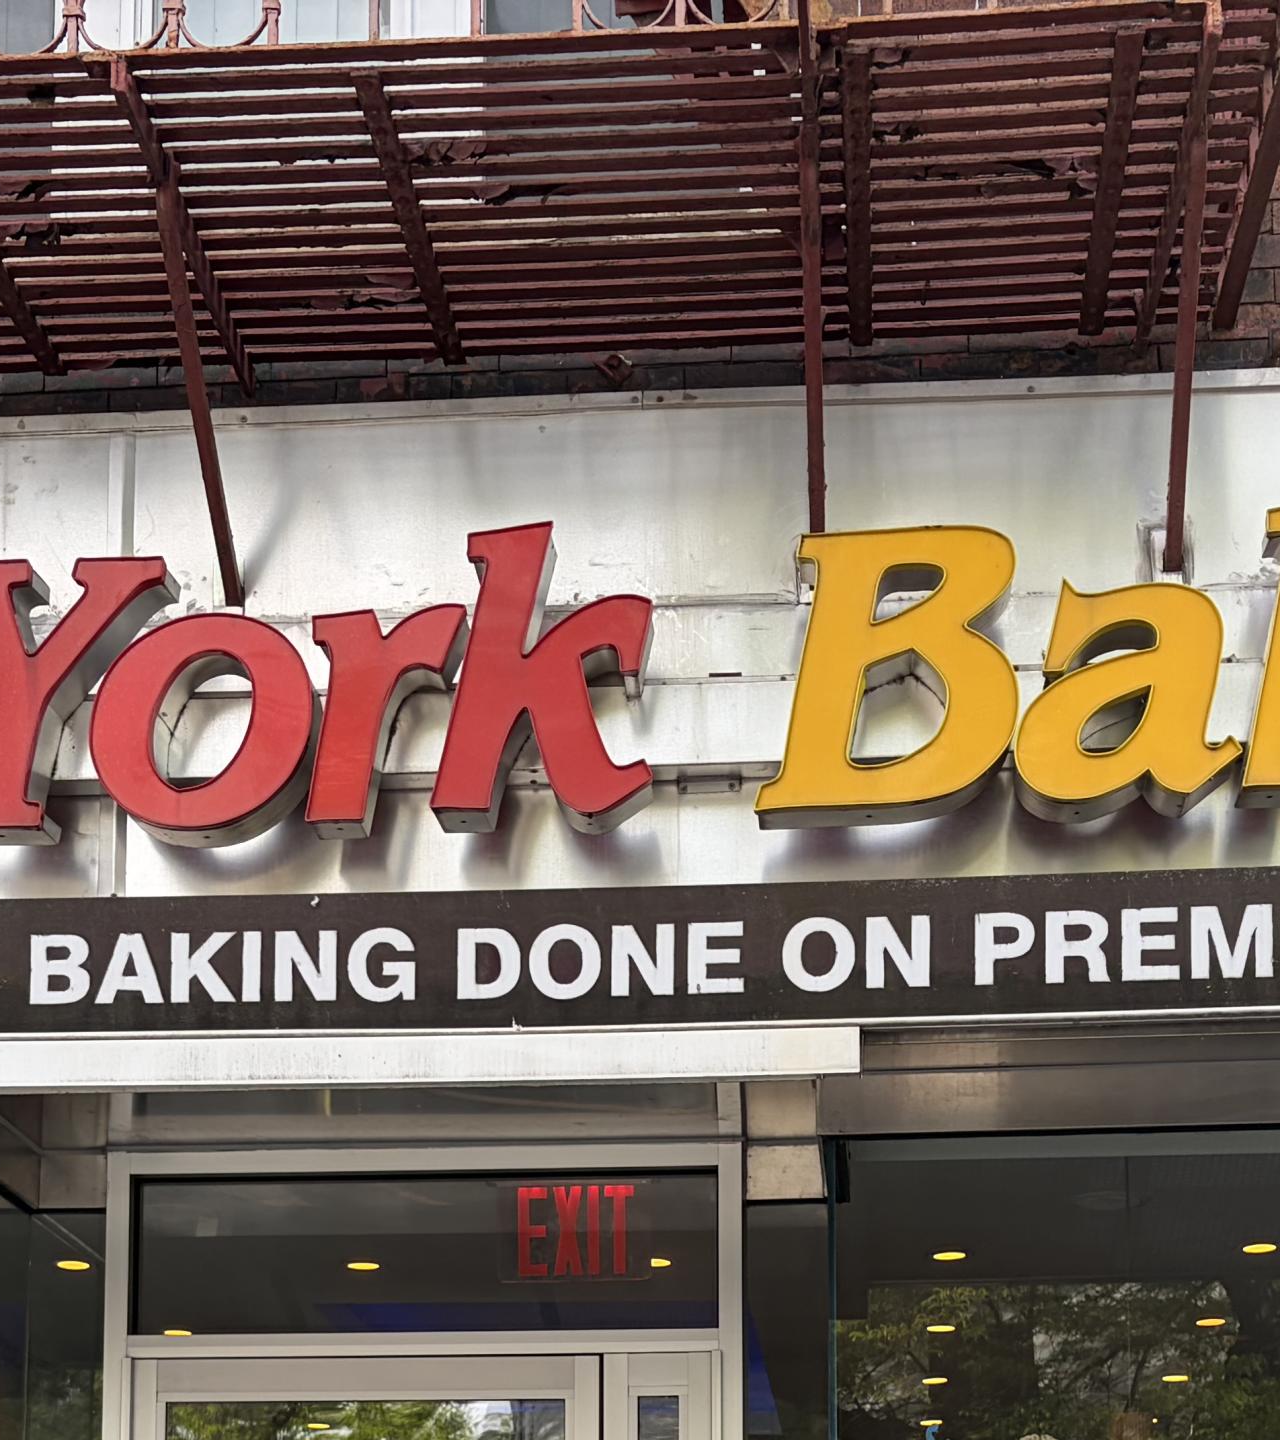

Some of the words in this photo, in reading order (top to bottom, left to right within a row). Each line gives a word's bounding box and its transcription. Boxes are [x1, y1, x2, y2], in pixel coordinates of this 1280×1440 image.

[30, 928, 415, 1004] BAKING
[457, 921, 744, 999] DONE
[783, 915, 930, 991] ON
[517, 1185, 635, 1277] EXIT
